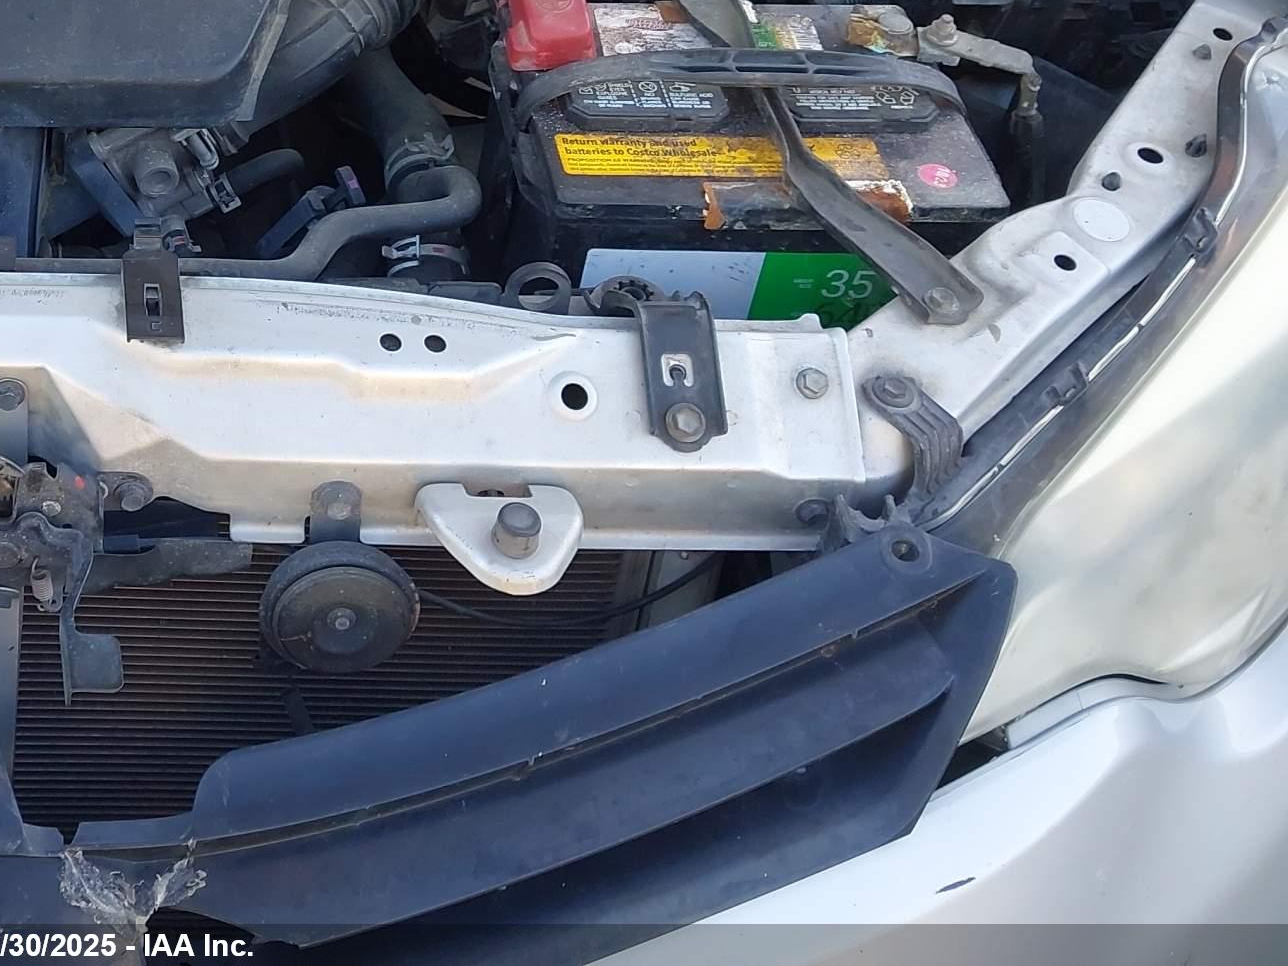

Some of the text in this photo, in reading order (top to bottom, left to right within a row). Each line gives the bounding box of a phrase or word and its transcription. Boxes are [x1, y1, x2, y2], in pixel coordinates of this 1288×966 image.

[562, 138, 697, 148] Return warranty and used
[565, 147, 717, 157] batteries to Costco Wholesale
[821, 270, 877, 299] 35
